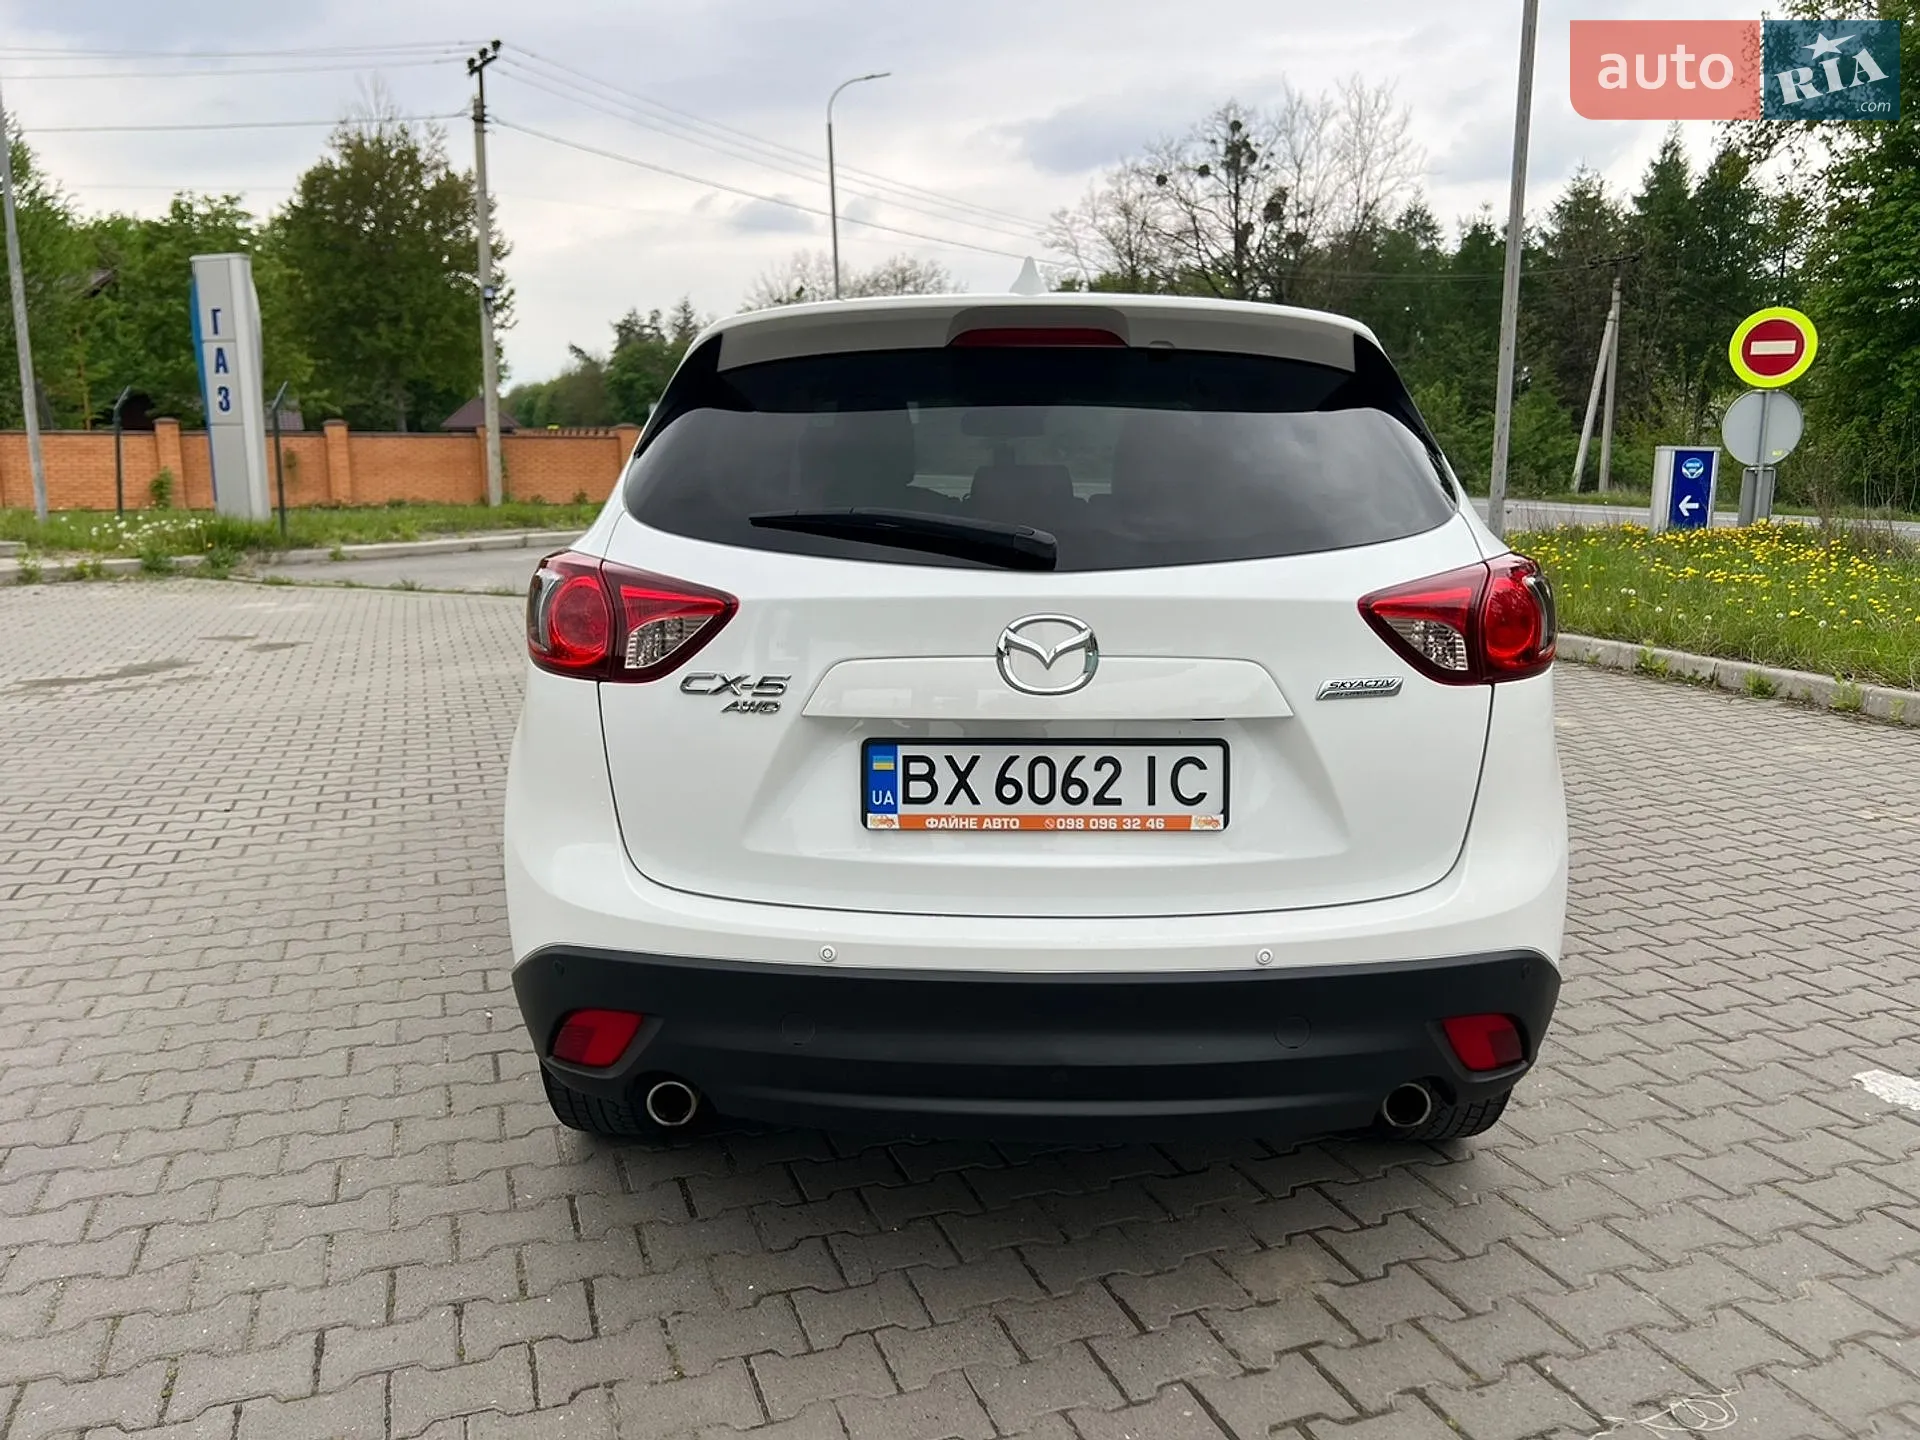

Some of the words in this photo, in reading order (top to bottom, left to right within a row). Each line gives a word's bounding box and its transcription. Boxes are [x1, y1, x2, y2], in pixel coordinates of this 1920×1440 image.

[212, 309, 230, 411] ГАЗ
[680, 672, 792, 697] CX-5
[1329, 678, 1397, 689] SKYACTIV
[721, 701, 780, 714] AWD
[902, 755, 981, 806] BX
[995, 755, 1122, 806] 6062
[1147, 755, 1208, 806] IC
[872, 790, 895, 806] UA
[925, 816, 978, 830] ФАЙНЕ
[982, 817, 1020, 830] АВТО
[1056, 817, 1085, 830] 098
[1089, 817, 1118, 830] 096
[1122, 817, 1142, 830] 32
[1145, 817, 1165, 830] 46
